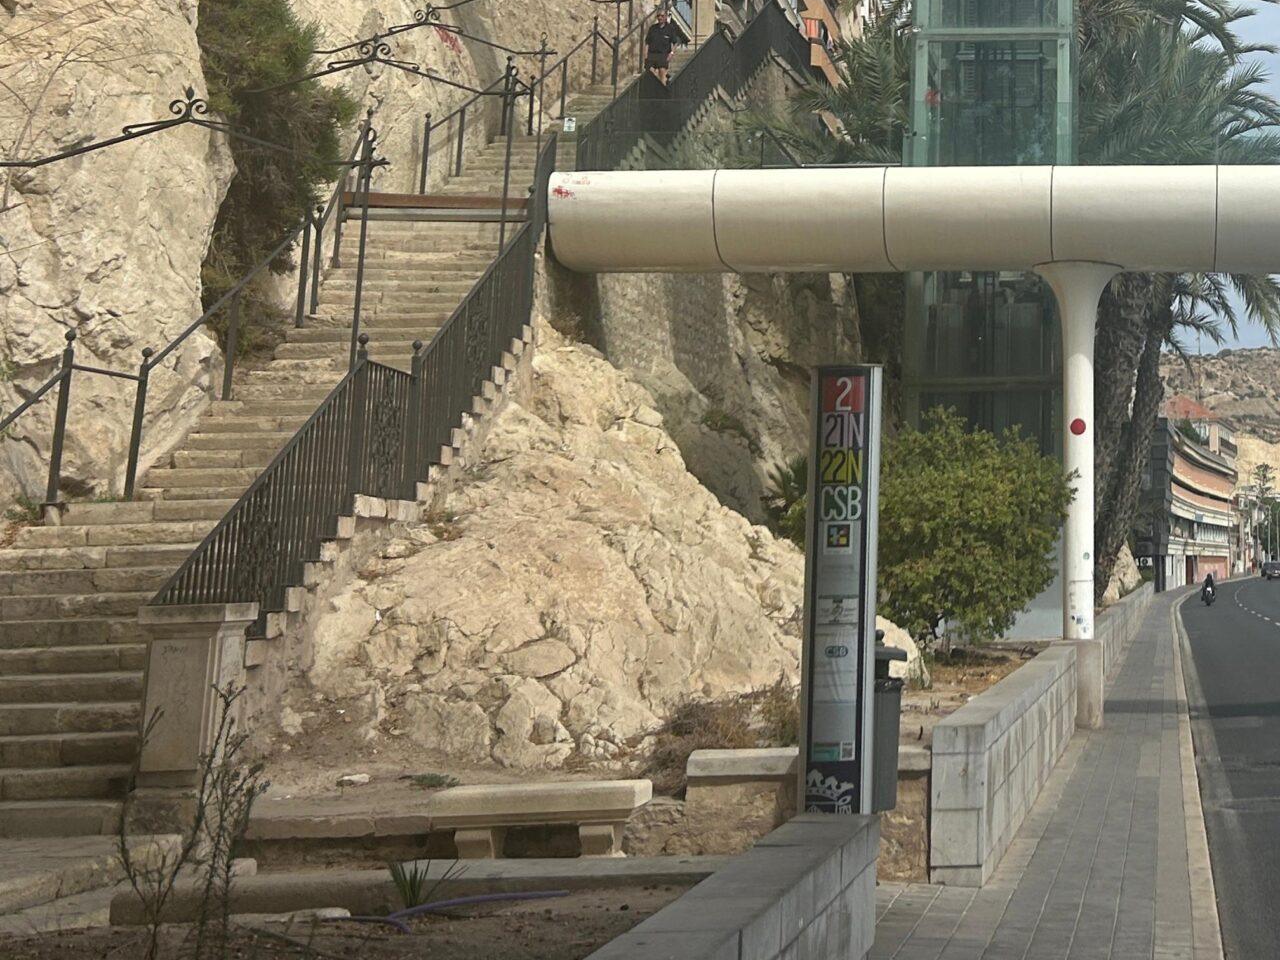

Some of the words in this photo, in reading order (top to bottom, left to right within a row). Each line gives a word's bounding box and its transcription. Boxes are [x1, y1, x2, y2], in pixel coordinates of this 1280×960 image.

[835, 376, 852, 412] 2
[824, 412, 864, 448] 21N
[821, 449, 863, 484] 22N
[820, 485, 862, 521] CSB
